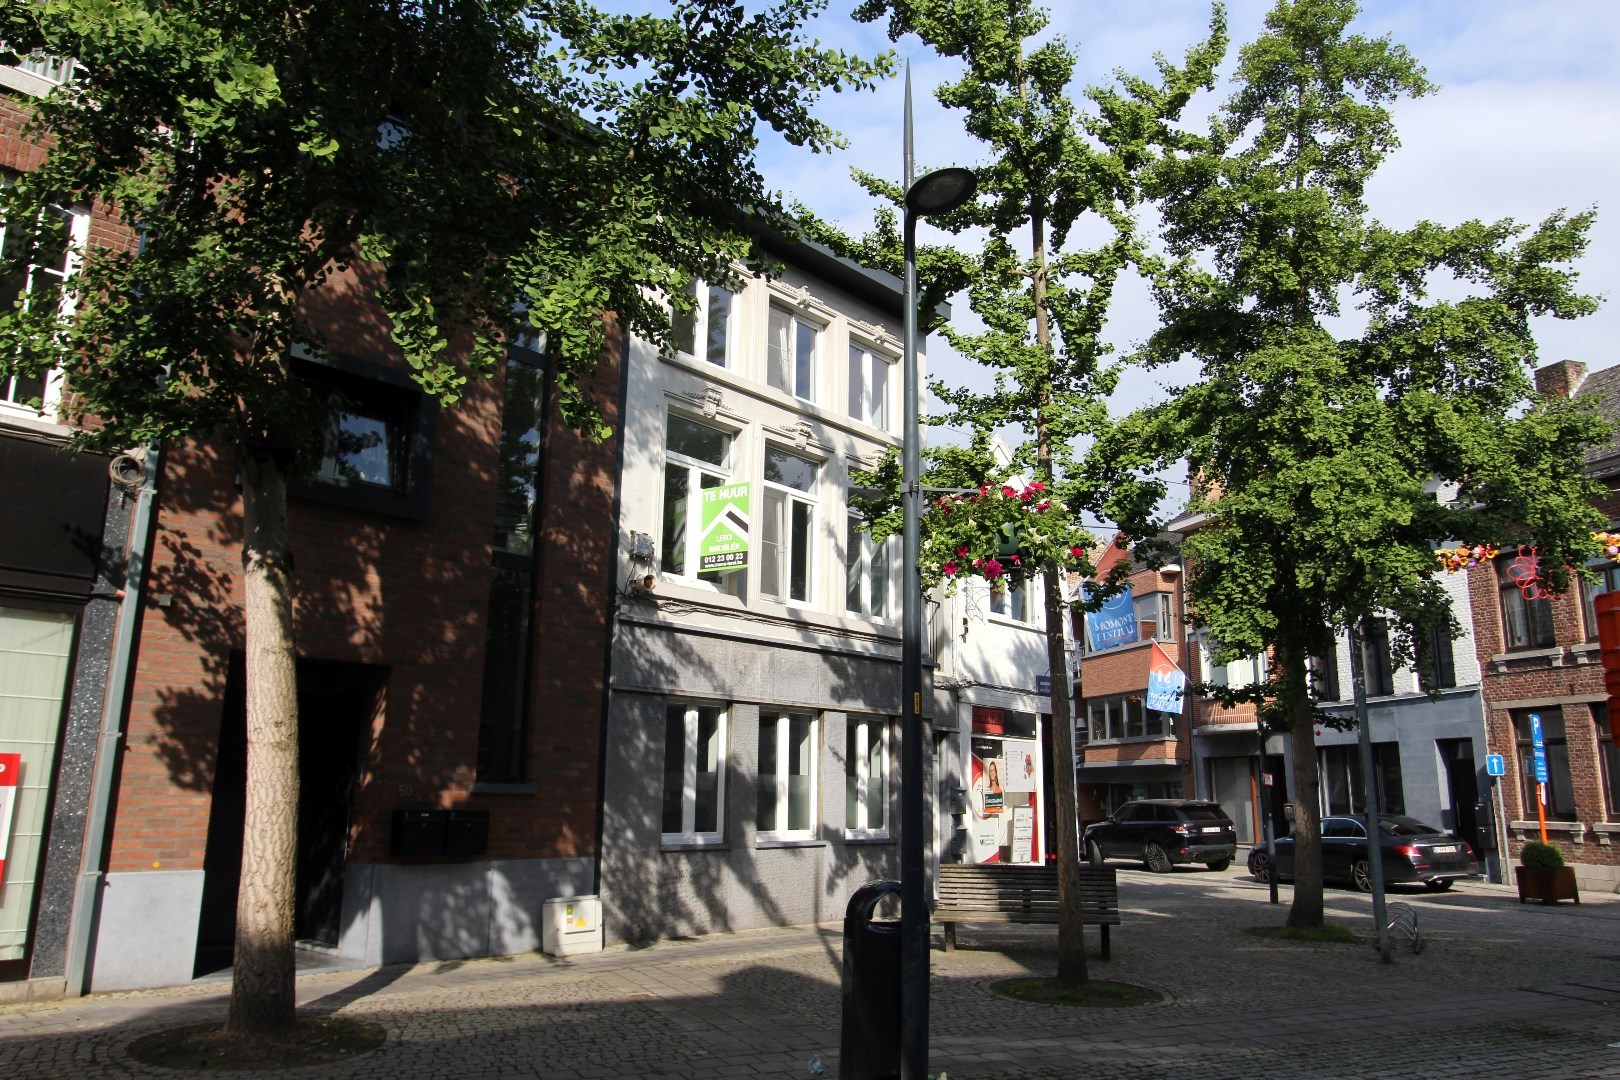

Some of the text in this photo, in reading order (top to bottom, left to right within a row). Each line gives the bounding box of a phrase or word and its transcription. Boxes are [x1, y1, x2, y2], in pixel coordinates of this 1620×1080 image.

[704, 486, 747, 502] TE HUUR
[716, 534, 733, 542] LEROI
[704, 552, 744, 564] 012 23 00 23
[399, 785, 413, 798] 50
